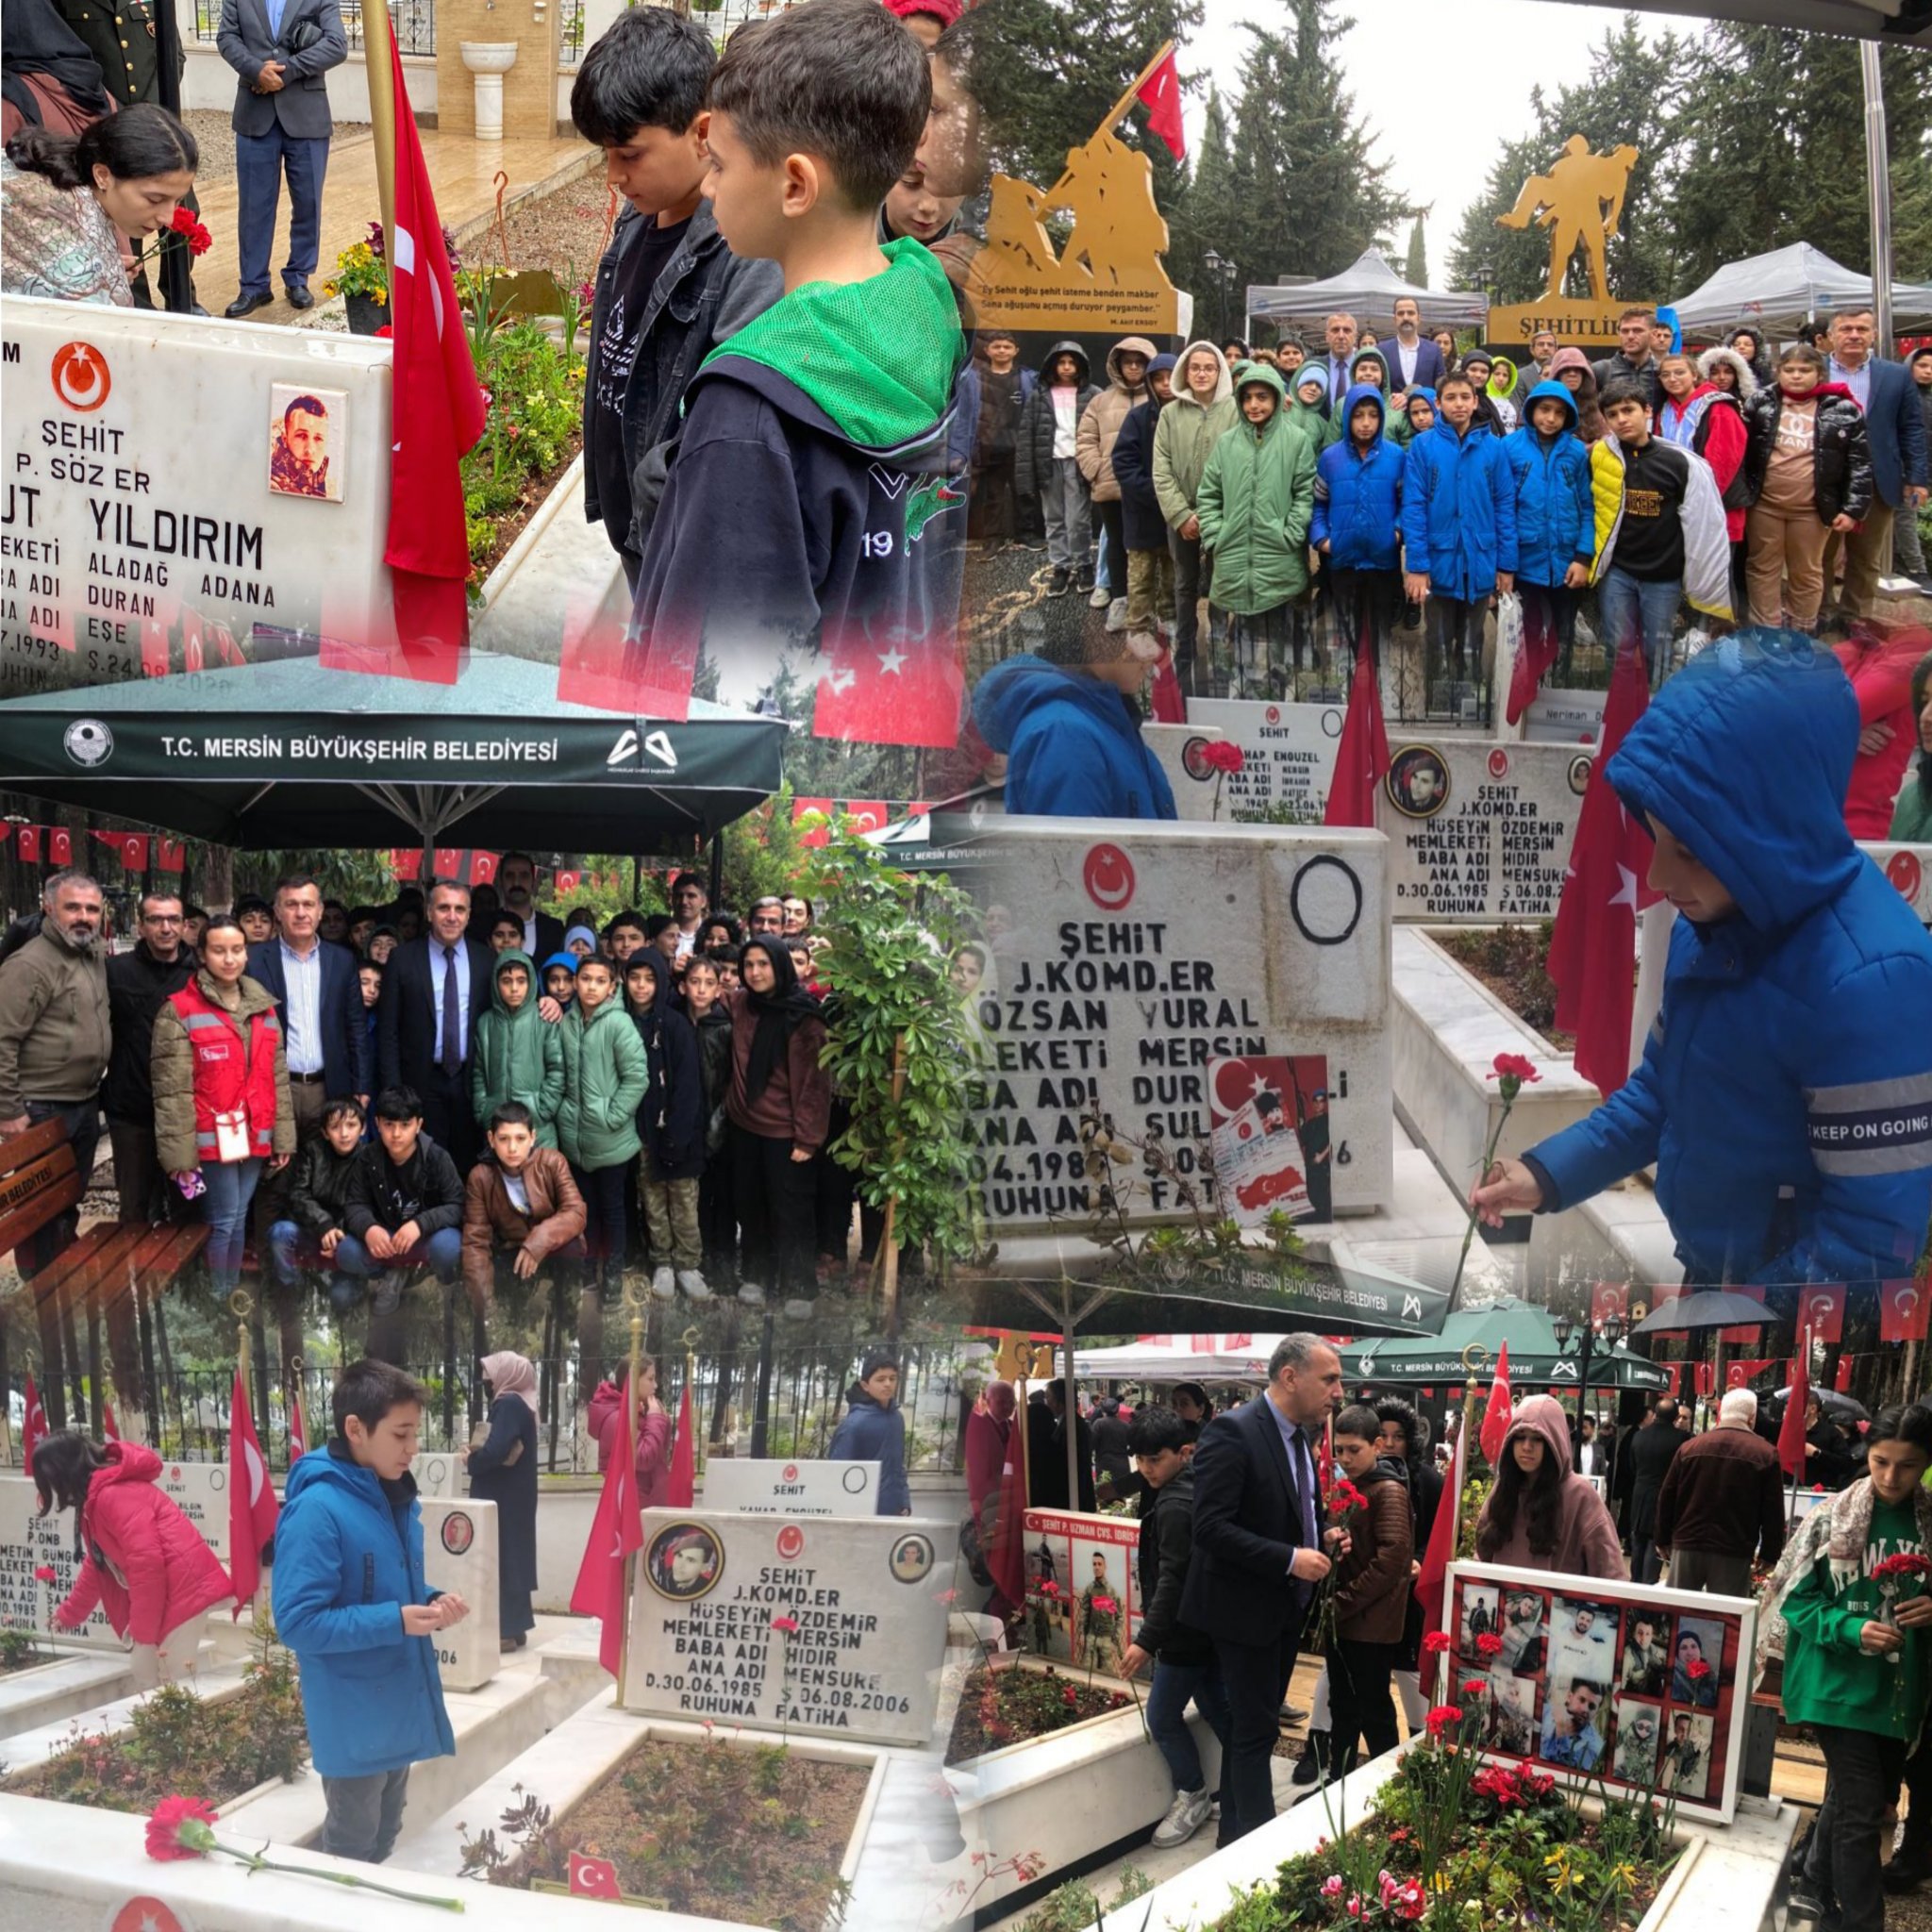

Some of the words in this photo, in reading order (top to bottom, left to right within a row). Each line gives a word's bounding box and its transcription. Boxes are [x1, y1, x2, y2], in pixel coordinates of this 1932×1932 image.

[1019, 287, 1039, 296] oğlu
[1092, 289, 1124, 298] benden
[1125, 290, 1159, 299] makber
[1069, 302, 1104, 312] duruyor
[41, 418, 125, 456] ŞEHİT
[90, 498, 265, 572] YILDIRIM
[861, 531, 894, 558] 19
[89, 552, 170, 589] ALADAĞ
[200, 574, 276, 608] ADANA
[29, 573, 60, 598] ADI
[88, 585, 156, 619] DURAN
[29, 605, 60, 630] ADI
[88, 617, 127, 645] EŞE
[160, 737, 199, 757] T.C.
[204, 734, 283, 758] MERSİN
[290, 735, 428, 764] BÜYÜKŞEHİR
[433, 738, 558, 762] BELEDİYESİ
[1501, 817, 1565, 837] ÖZDEMİR
[1406, 835, 1491, 850] MEMLEKETİ
[1502, 837, 1555, 851] MERSİN
[1417, 850, 1458, 866] BABA
[1465, 852, 1491, 866] ADI
[1429, 868, 1459, 882] ANA
[1466, 868, 1491, 883] ADI
[1426, 899, 1486, 913] RUHUNA
[1499, 899, 1552, 914] FATİHA
[1058, 922, 1168, 960] ŞEHİT
[1013, 960, 1217, 994] J.KOMD.ER
[1135, 997, 1260, 1031] VURAL
[1812, 1124, 1850, 1140] KEEP
[1853, 1123, 1878, 1140] ON
[1880, 1115, 1929, 1137] GOING
[1241, 1268, 1281, 1291] MERSİN
[1284, 1275, 1342, 1303] BÜYÜKŞEHİR
[1343, 1291, 1389, 1312] BELEDİYESİ
[1405, 1361, 1433, 1373] MERSİN
[1070, 1522, 1095, 1537] UZMAN
[733, 1584, 841, 1607] J.KOMD.ER
[689, 1602, 773, 1624] HÜSEYİN
[662, 1619, 772, 1642] MEMLEKETİ
[787, 1628, 862, 1650] MERSİN
[675, 1637, 725, 1658] BABA
[736, 1642, 768, 1661] ADI
[785, 1646, 838, 1667] HIDIR
[687, 1658, 725, 1678] ANA
[735, 1662, 766, 1680] ADI
[645, 1672, 763, 1699] D.30.06.1985
[800, 1687, 910, 1714] 06.08.2006
[680, 1693, 758, 1717] RUHUNA
[775, 1703, 850, 1727] FATİHA
